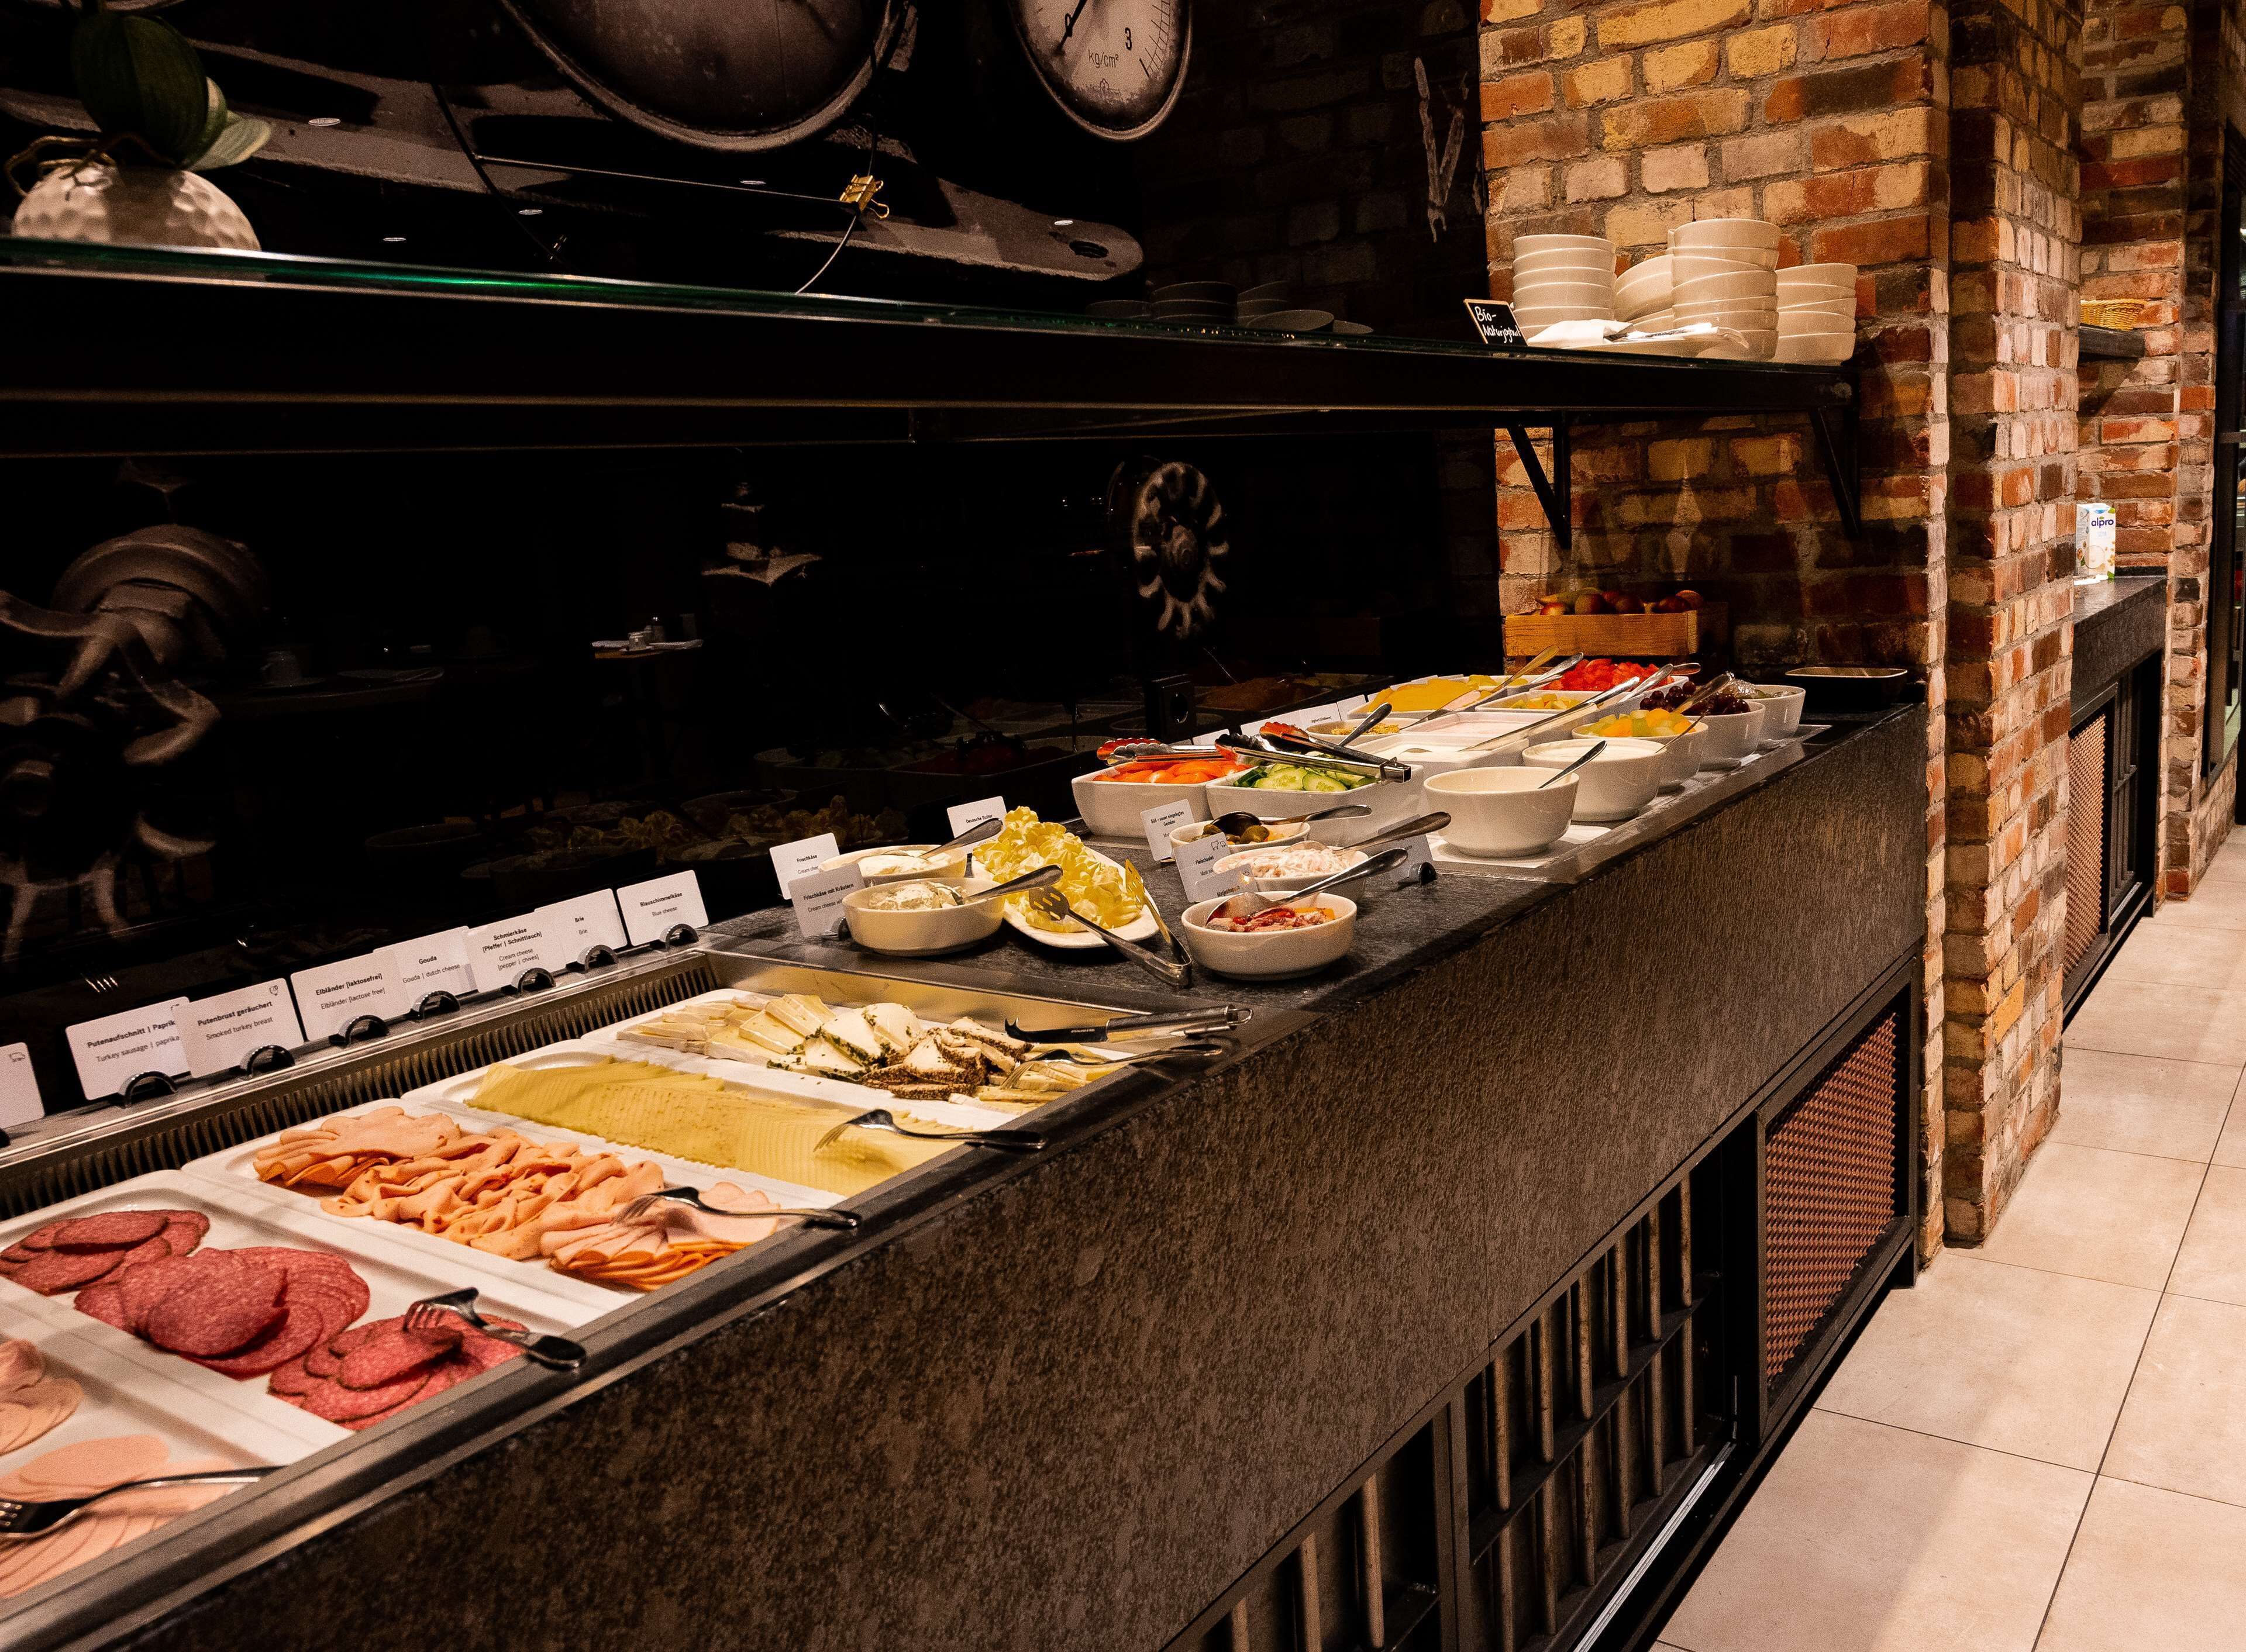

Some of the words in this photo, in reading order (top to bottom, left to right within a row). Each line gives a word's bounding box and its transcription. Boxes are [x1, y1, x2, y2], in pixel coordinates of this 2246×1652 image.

[1125, 27, 1132, 50] 3
[1474, 306, 1497, 322] Bio-
[2091, 518, 2114, 529] alpro
[797, 854, 817, 863] Frischkäse
[640, 893, 683, 907] Blauschimmelkäse
[803, 891, 826, 901] Frischkäse
[835, 884, 854, 892] Kräutern
[482, 943, 502, 953] [Pfeffer
[508, 931, 542, 944] Schnittlauch]
[493, 929, 527, 940] Schmierkäse
[419, 956, 438, 964] Gouda
[499, 953, 516, 961] Cream
[516, 949, 533, 957] cheese
[402, 974, 421, 983] Gouda
[426, 968, 442, 977] dutch
[442, 964, 460, 972] cheese
[315, 984, 345, 995] Elbländer
[346, 972, 383, 989] [laktosefrei]
[321, 998, 347, 1009] Elbländer
[349, 992, 371, 1003] [lactose
[197, 1011, 235, 1026] Putenbrust
[236, 1001, 273, 1017] geräuchert
[87, 1028, 146, 1048] Putenaufschnitt
[153, 1020, 175, 1030] Paprik
[206, 1028, 232, 1040] Smoked
[233, 1023, 253, 1033] turkey
[254, 1016, 273, 1027] breast
[97, 1053, 119, 1063] Turkey
[120, 1044, 149, 1056] sausage
[156, 1036, 180, 1047] paprika
